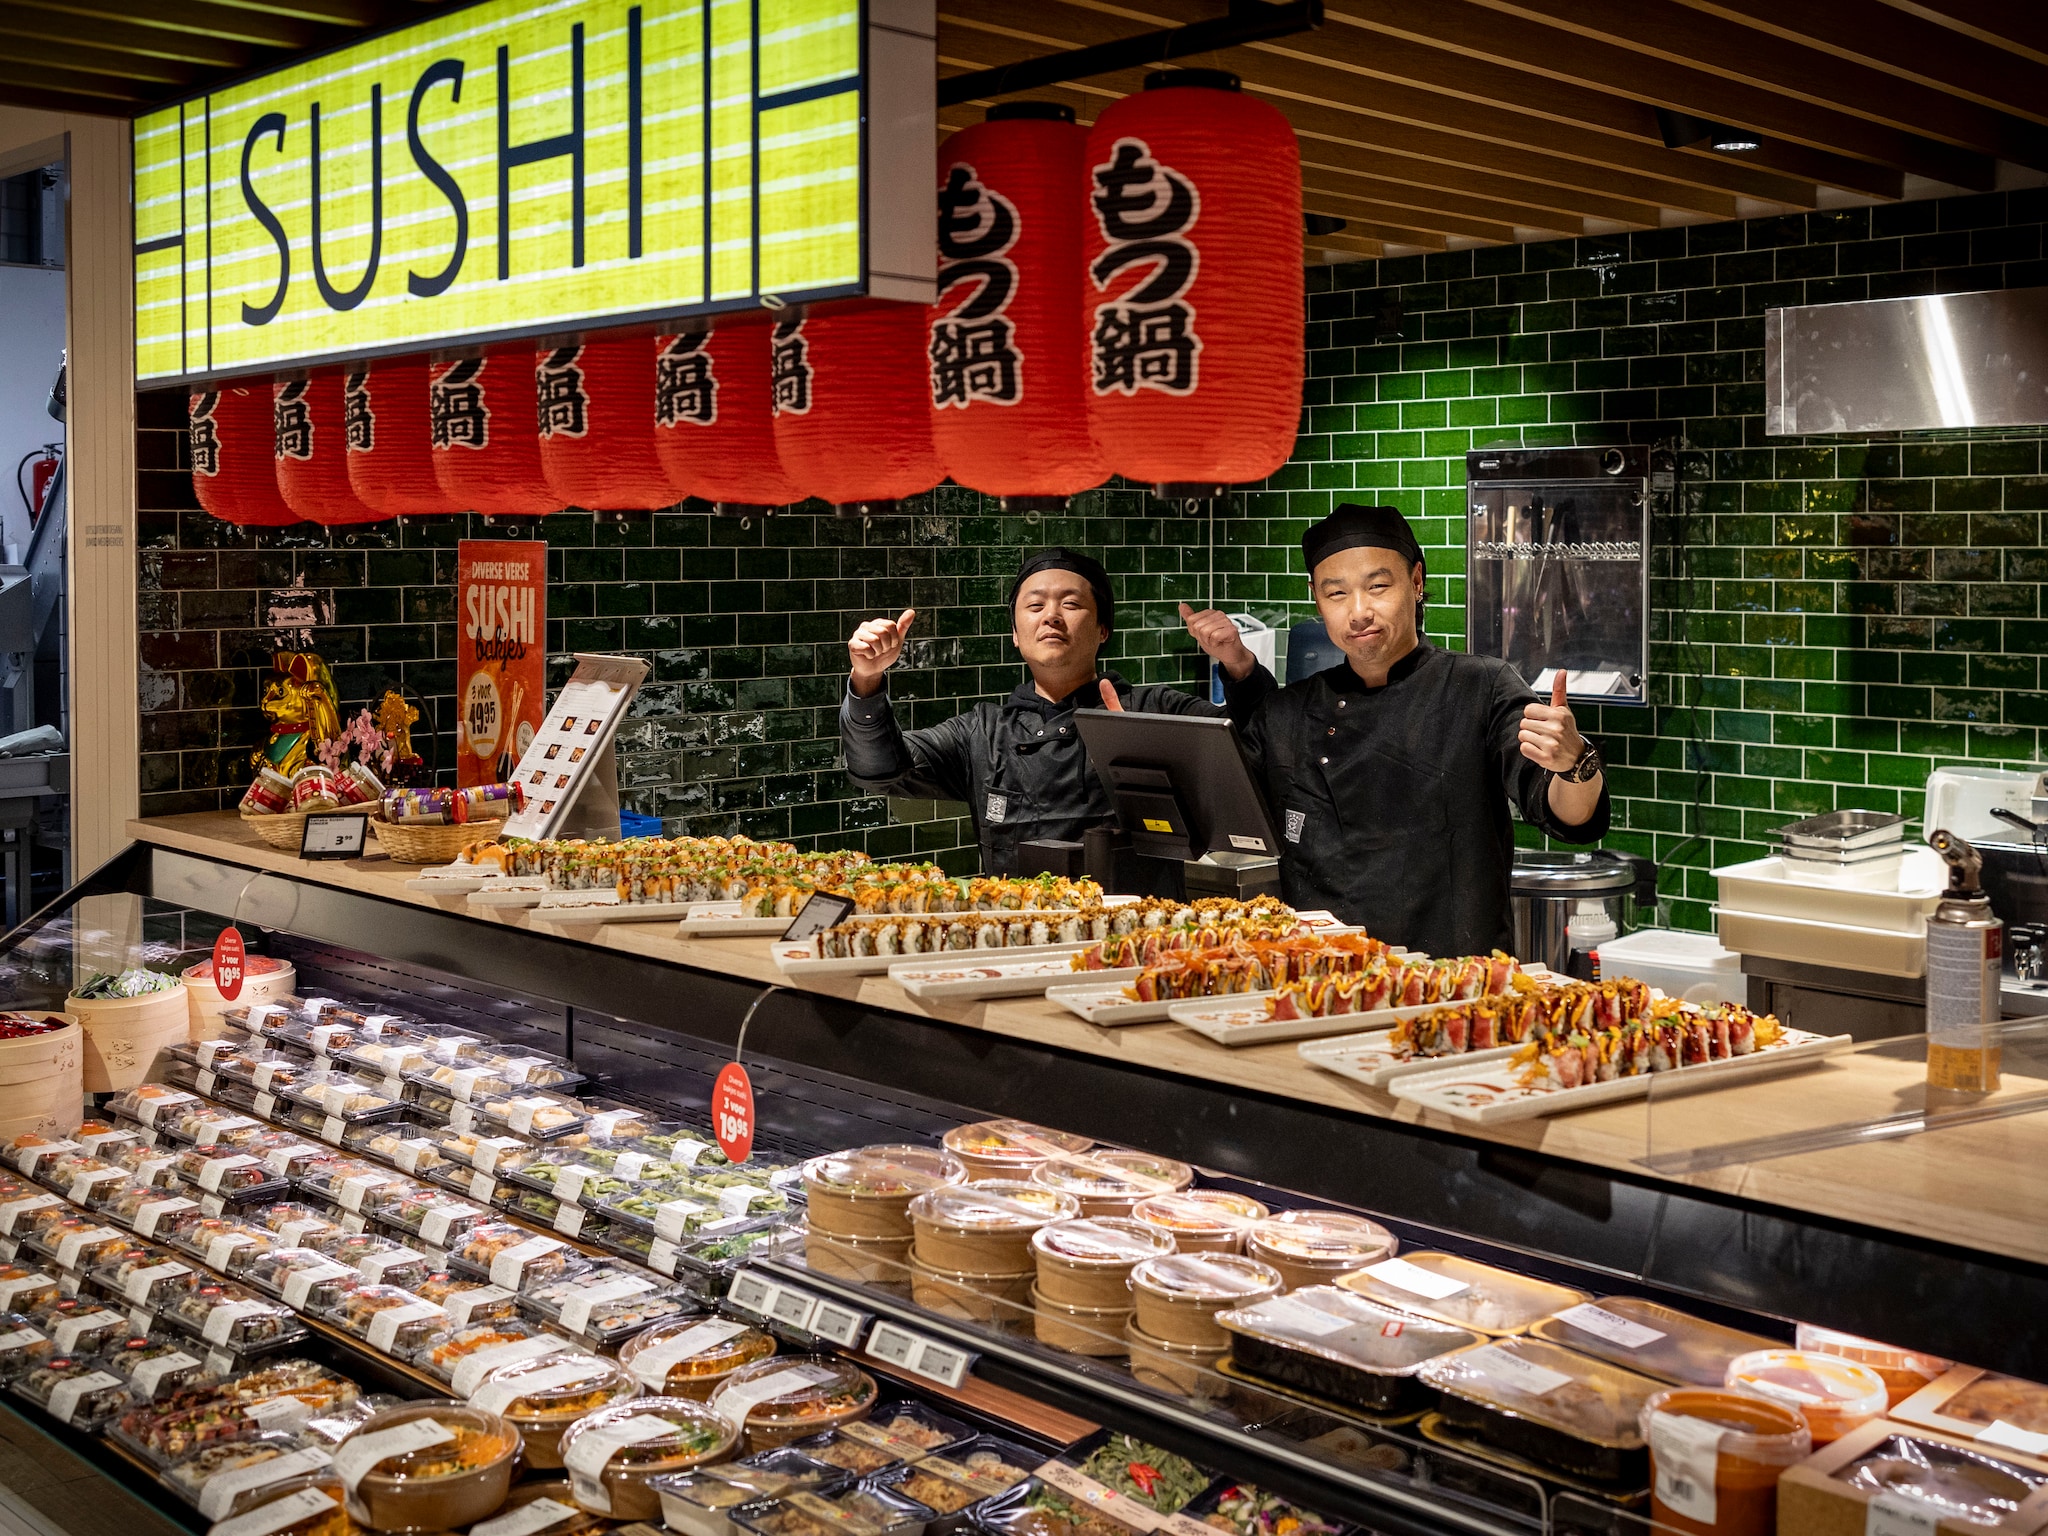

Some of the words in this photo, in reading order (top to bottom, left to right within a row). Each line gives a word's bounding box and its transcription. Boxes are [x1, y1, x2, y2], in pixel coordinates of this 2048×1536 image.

[241, 5, 643, 327] SUSHI
[928, 163, 1024, 410] もつ鍋
[1091, 137, 1203, 396] もつ鍋
[472, 561, 503, 580] DIVERSE
[505, 562, 530, 581] VERSE
[466, 584, 536, 645] SUSHI
[475, 624, 527, 672] bakjes
[471, 685, 477, 700] 3
[222, 955, 226, 963] 3
[724, 1097, 729, 1109] 3
[730, 1100, 746, 1117] voor
